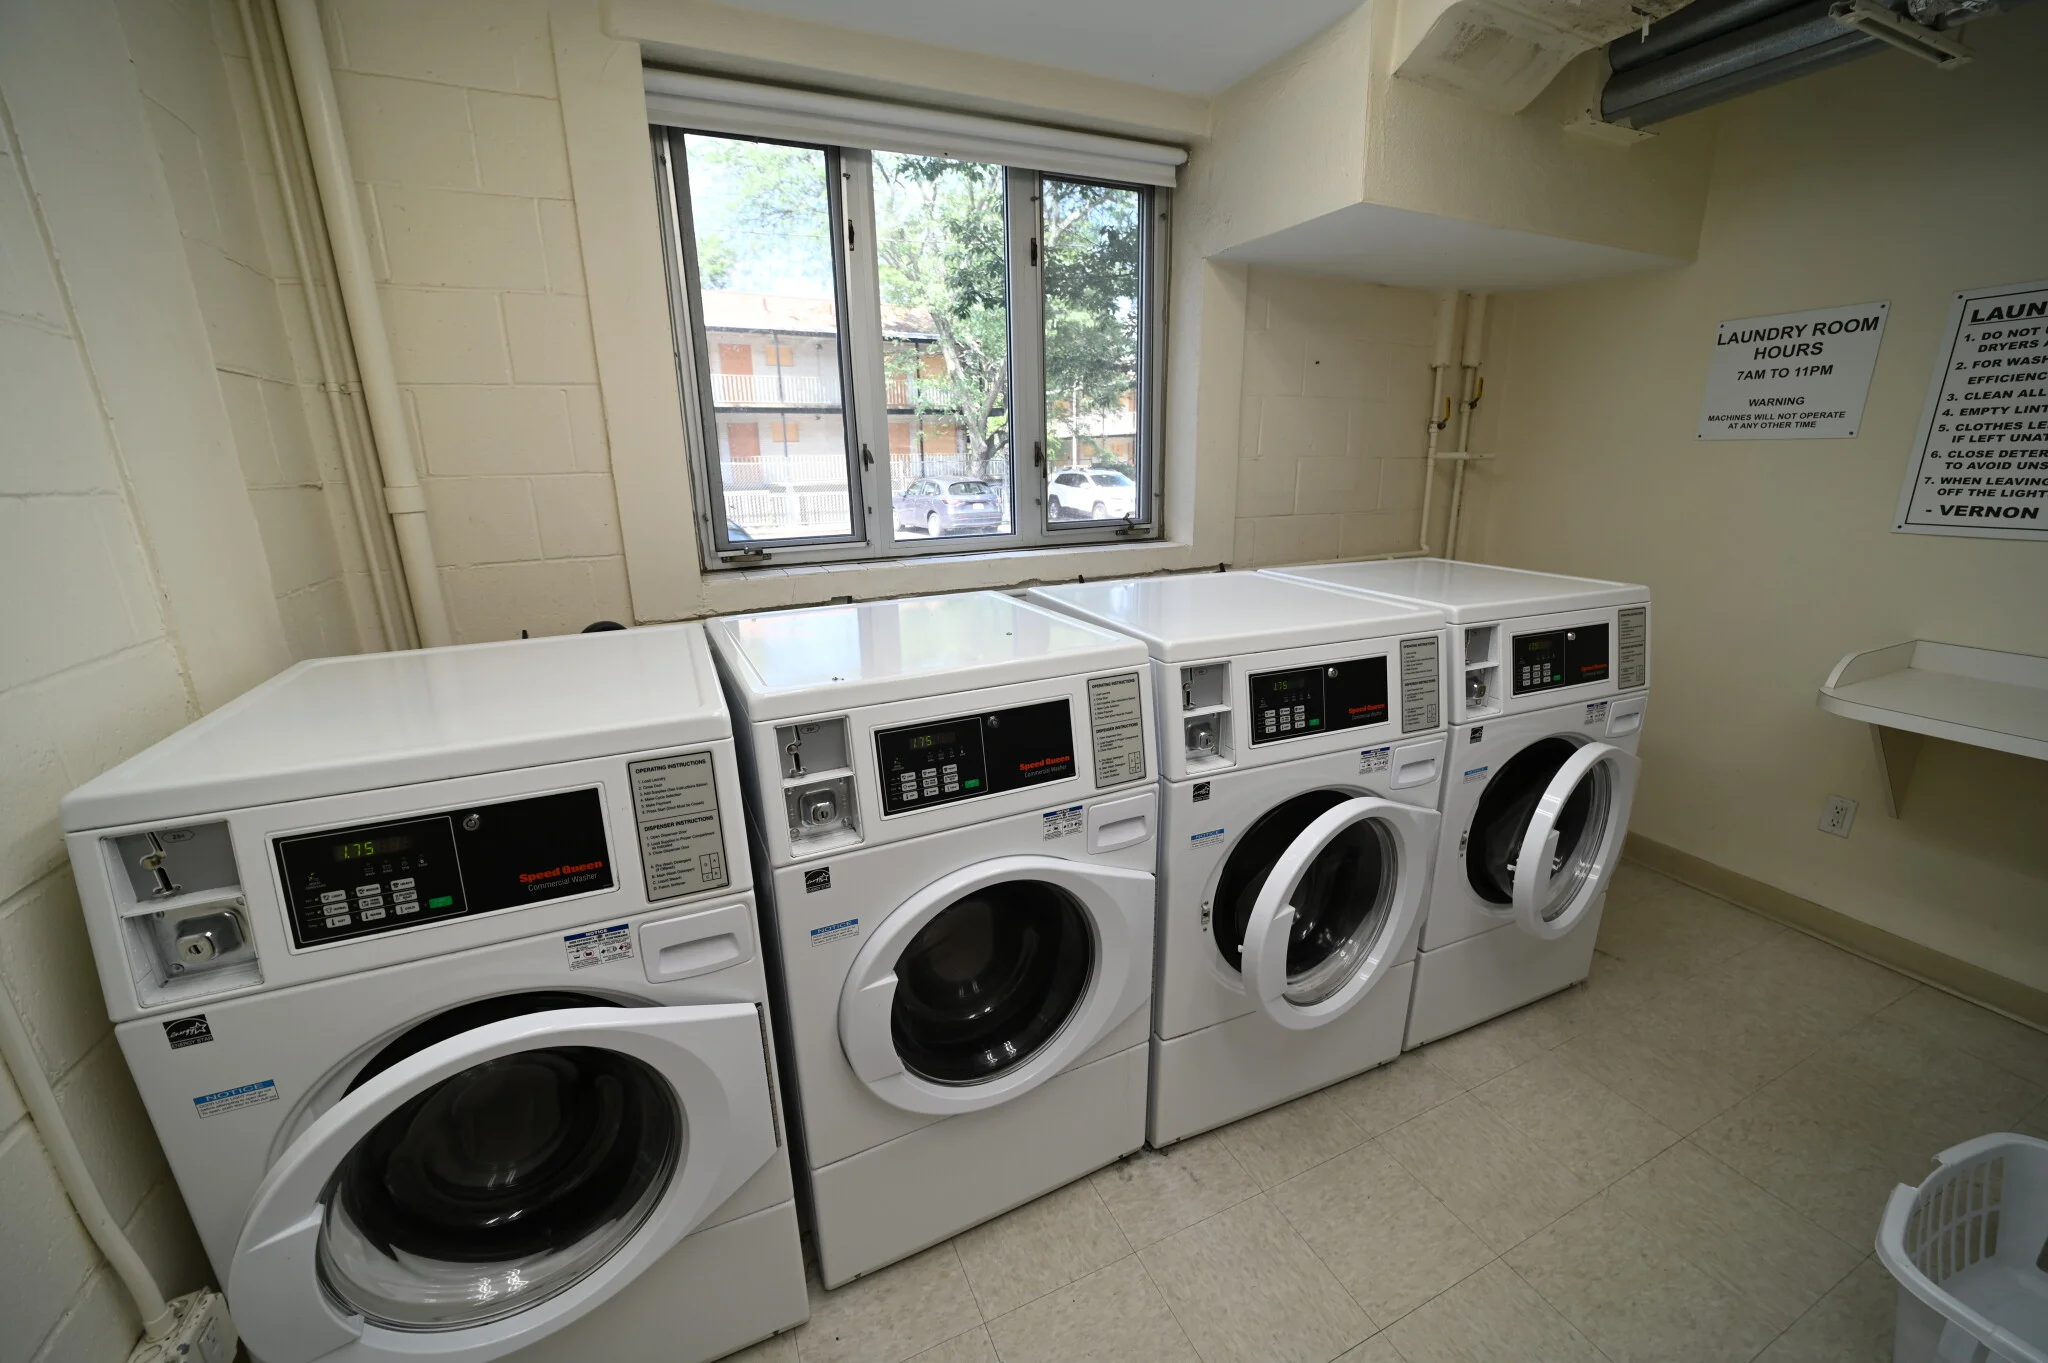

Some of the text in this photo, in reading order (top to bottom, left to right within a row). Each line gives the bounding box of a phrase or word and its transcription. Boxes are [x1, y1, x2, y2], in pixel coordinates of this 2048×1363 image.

[1717, 316, 1879, 345] LAUNDRY ROOM
[1964, 334, 1975, 342] 1.
[1982, 331, 2002, 340] DO
[2007, 327, 2041, 337] NOT
[1754, 342, 1823, 360] HOURS
[1978, 340, 2039, 352] DRYERS
[1955, 362, 1967, 370] 2.
[1972, 360, 2002, 369] FOR
[1737, 365, 1833, 380] 7AM TO 11PM
[1749, 397, 1804, 406] WARNING
[1964, 390, 2013, 400] CLEAN
[2018, 389, 2046, 397] ALL
[1800, 411, 1846, 419] OPERATE
[1959, 406, 2010, 416] EMPTY
[2015, 405, 2048, 414] LINT
[1938, 424, 1949, 432] 5.
[1955, 422, 2023, 431] CLOTHES
[1952, 435, 1965, 443] IF
[1948, 450, 1994, 458] CLOSE
[2017, 462, 2048, 470] UNS
[1940, 477, 1982, 485] WHEN
[1940, 505, 2039, 519] VERNON
[636, 759, 706, 774] OPERATING INSTRUCTIONS
[1020, 756, 1069, 771] Speed Queen
[644, 816, 713, 831] DISPENSER INSTRUCTIONS
[344, 842, 374, 859] 1.75
[519, 861, 603, 882] Speed Queen
[528, 872, 597, 891] Commercial Washer
[172, 1035, 213, 1049] ENERGY STAR
[206, 1083, 264, 1101] NOTICE
